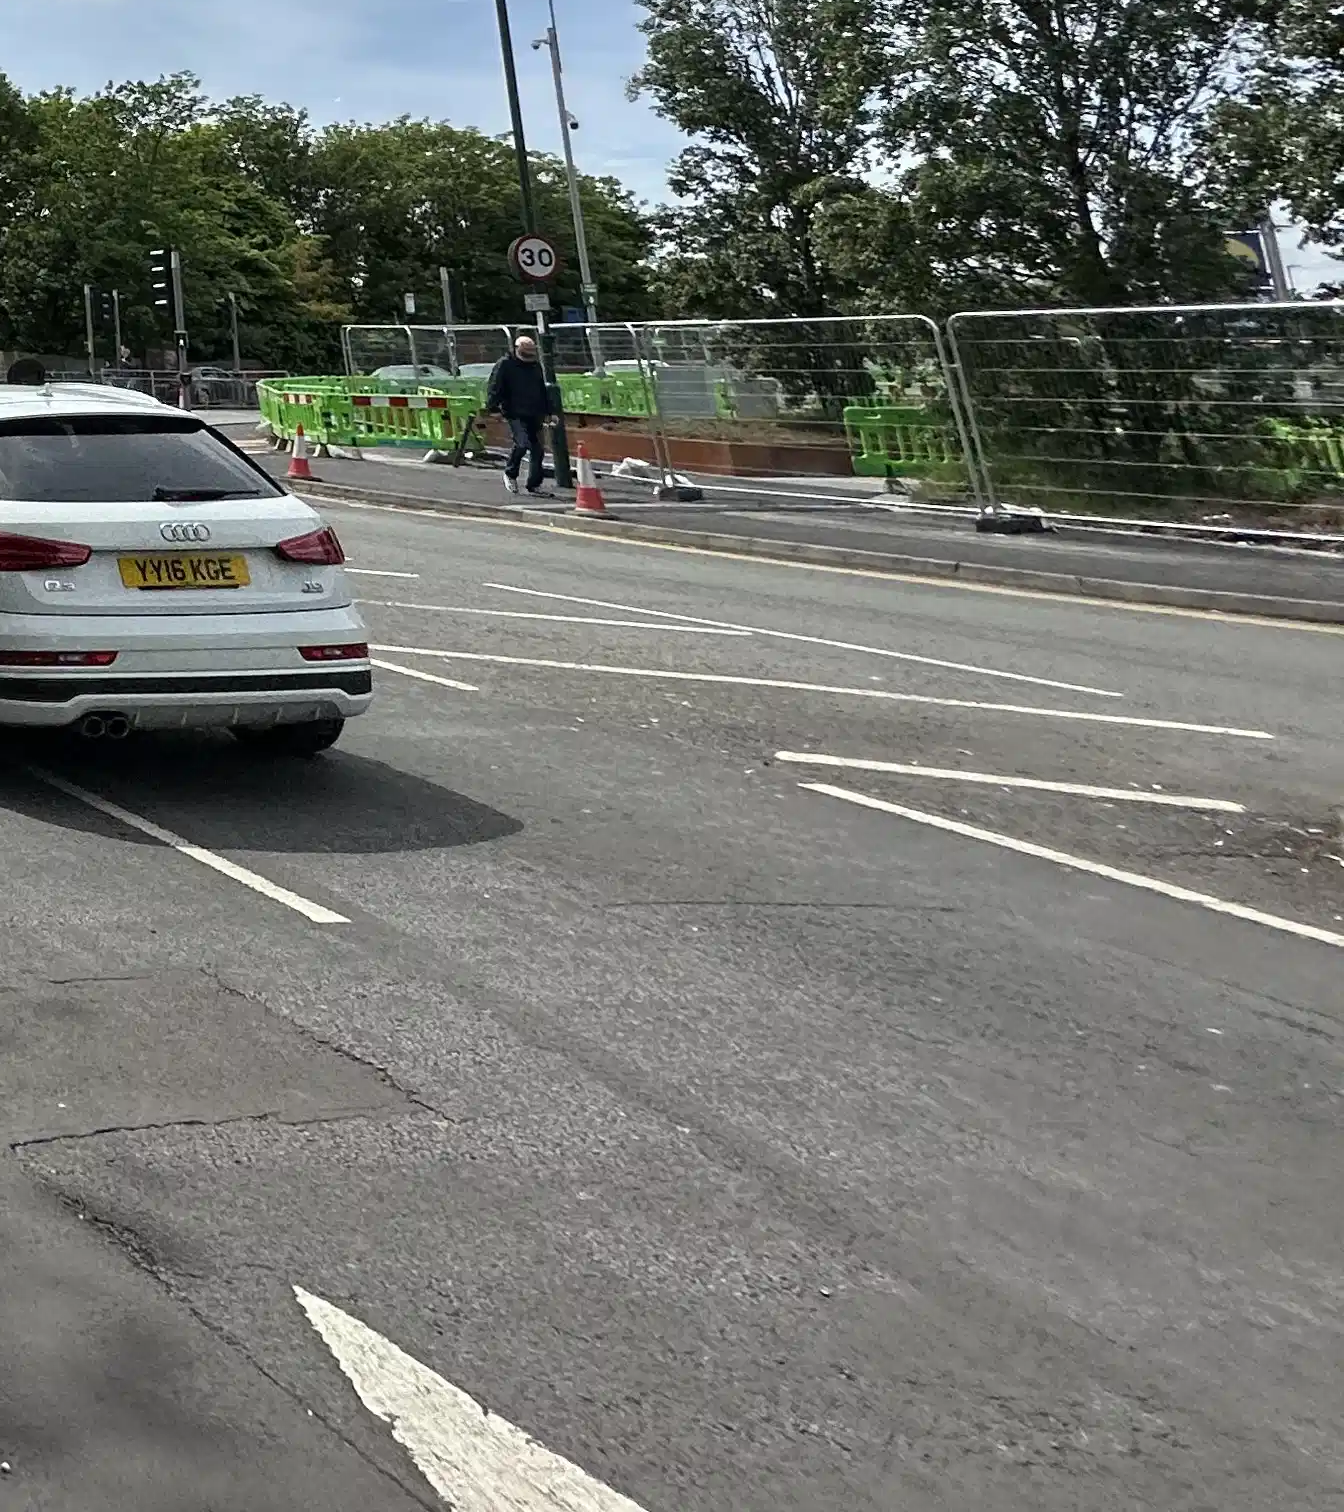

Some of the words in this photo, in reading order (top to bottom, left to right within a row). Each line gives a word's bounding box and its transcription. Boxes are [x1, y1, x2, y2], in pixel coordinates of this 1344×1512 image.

[520, 248, 553, 267] 30
[134, 559, 186, 582] YY16
[188, 558, 236, 581] KGE
